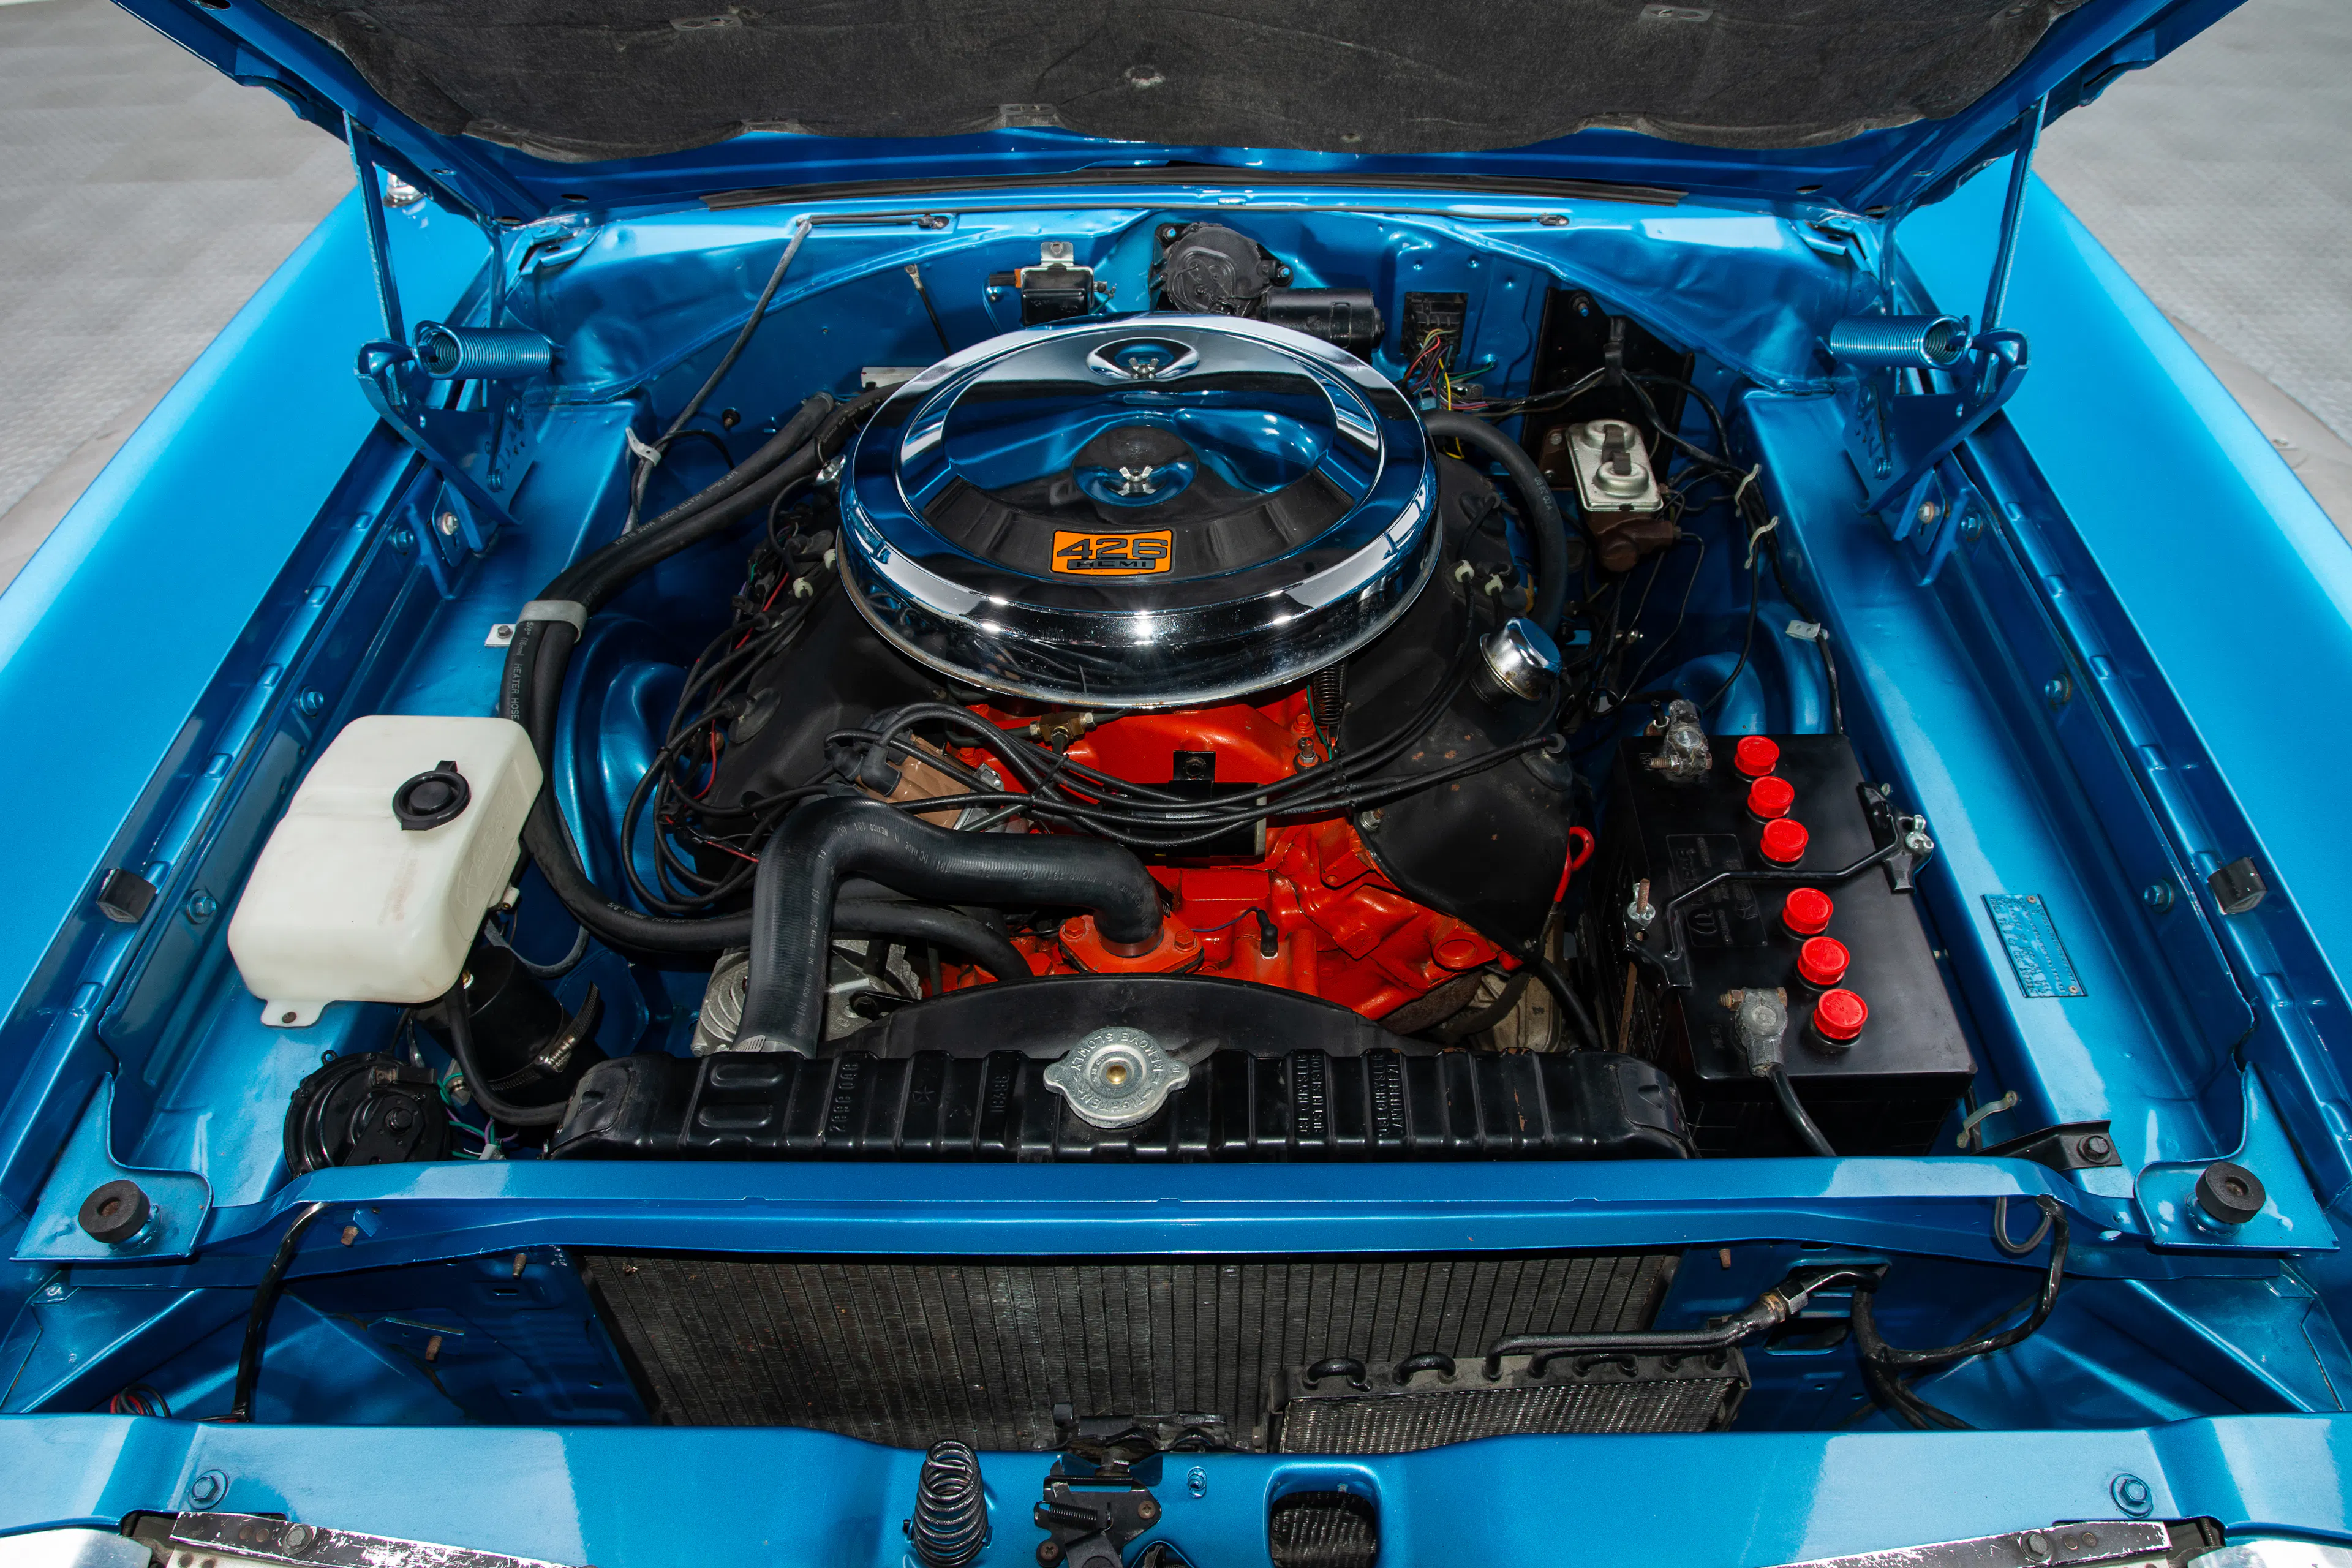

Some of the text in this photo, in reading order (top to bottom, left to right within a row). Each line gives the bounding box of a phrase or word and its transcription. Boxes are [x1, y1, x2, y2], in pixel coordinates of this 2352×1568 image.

[679, 493, 704, 510] HEATER
[660, 508, 677, 522] HOSE
[636, 521, 656, 533] MADE
[1057, 538, 1169, 560] 426
[511, 663, 522, 695] HEATER
[511, 697, 520, 720] HOSE
[1523, 737, 1542, 747] Belden
[808, 957, 815, 965] IN
[803, 974, 813, 998] MEXICO
[1071, 1033, 1163, 1072] REMOVE SLOWLY
[1080, 1093, 1147, 1114] TIGHTEN
